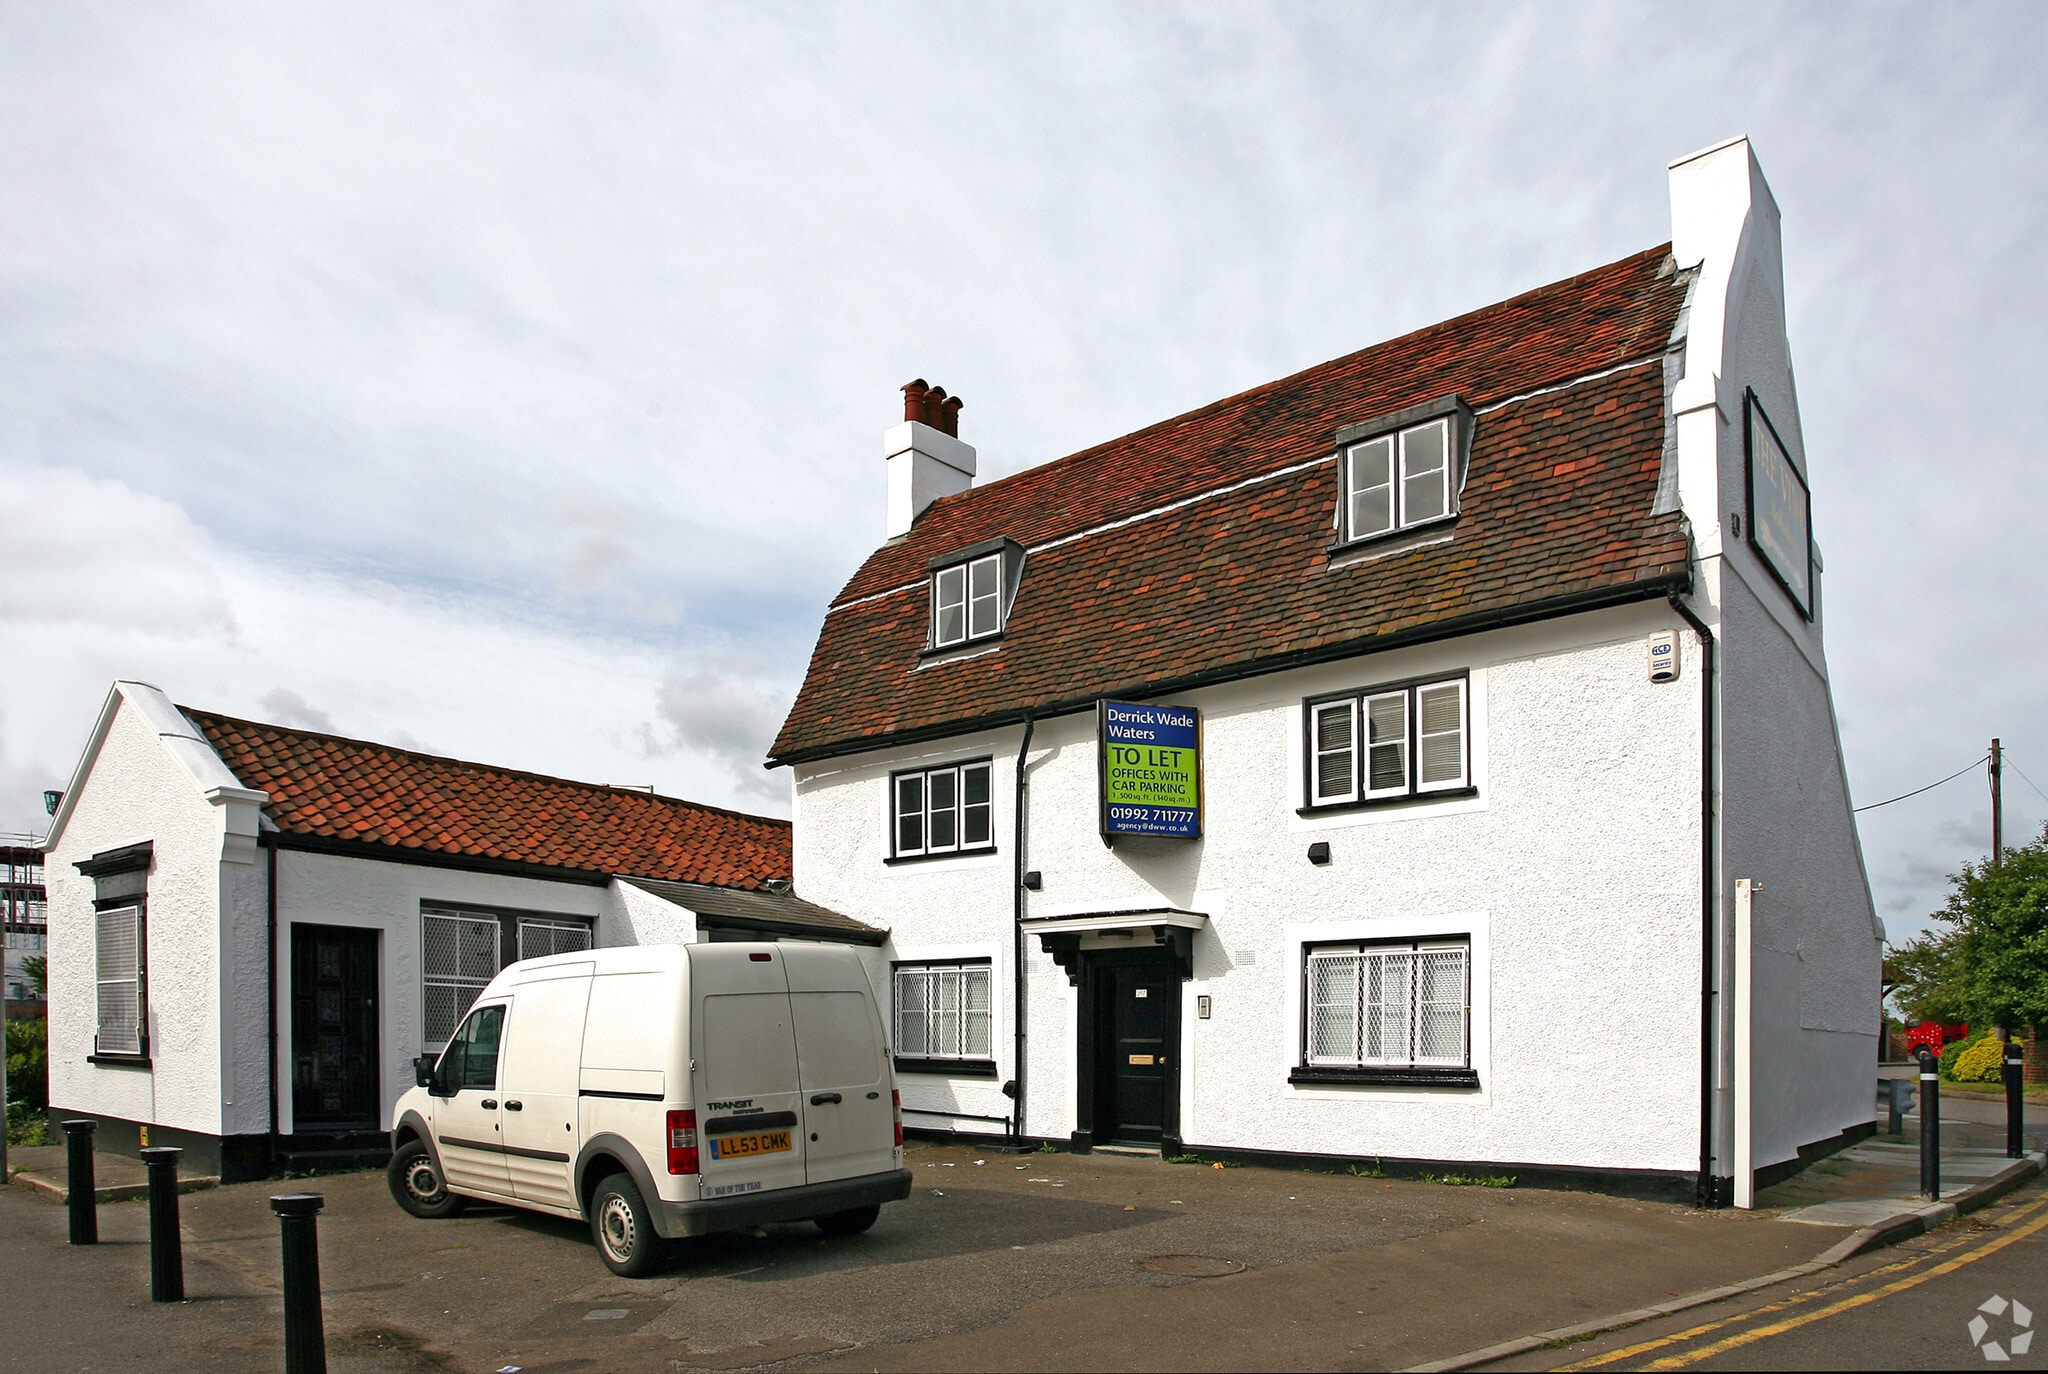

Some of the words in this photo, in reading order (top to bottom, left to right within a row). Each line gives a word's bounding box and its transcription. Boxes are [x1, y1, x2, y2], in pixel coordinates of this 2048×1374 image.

[1108, 709, 1155, 724] Derrick
[1157, 713, 1194, 727] Wade
[1108, 725, 1155, 740] Waters
[1112, 746, 1141, 765] TO
[1148, 749, 1182, 768] LET
[1112, 768, 1155, 780] OFFICES
[1159, 771, 1189, 782] WITH
[1112, 780, 1136, 791] CAR
[1140, 782, 1186, 794] PARKING
[1110, 807, 1148, 820] 01992
[1153, 810, 1194, 823] 711777
[1117, 822, 1188, 832] agency@dww.co.uk
[706, 1099, 753, 1110] TRANSIT
[720, 1137, 758, 1155] LL53
[761, 1133, 788, 1150] CMK
